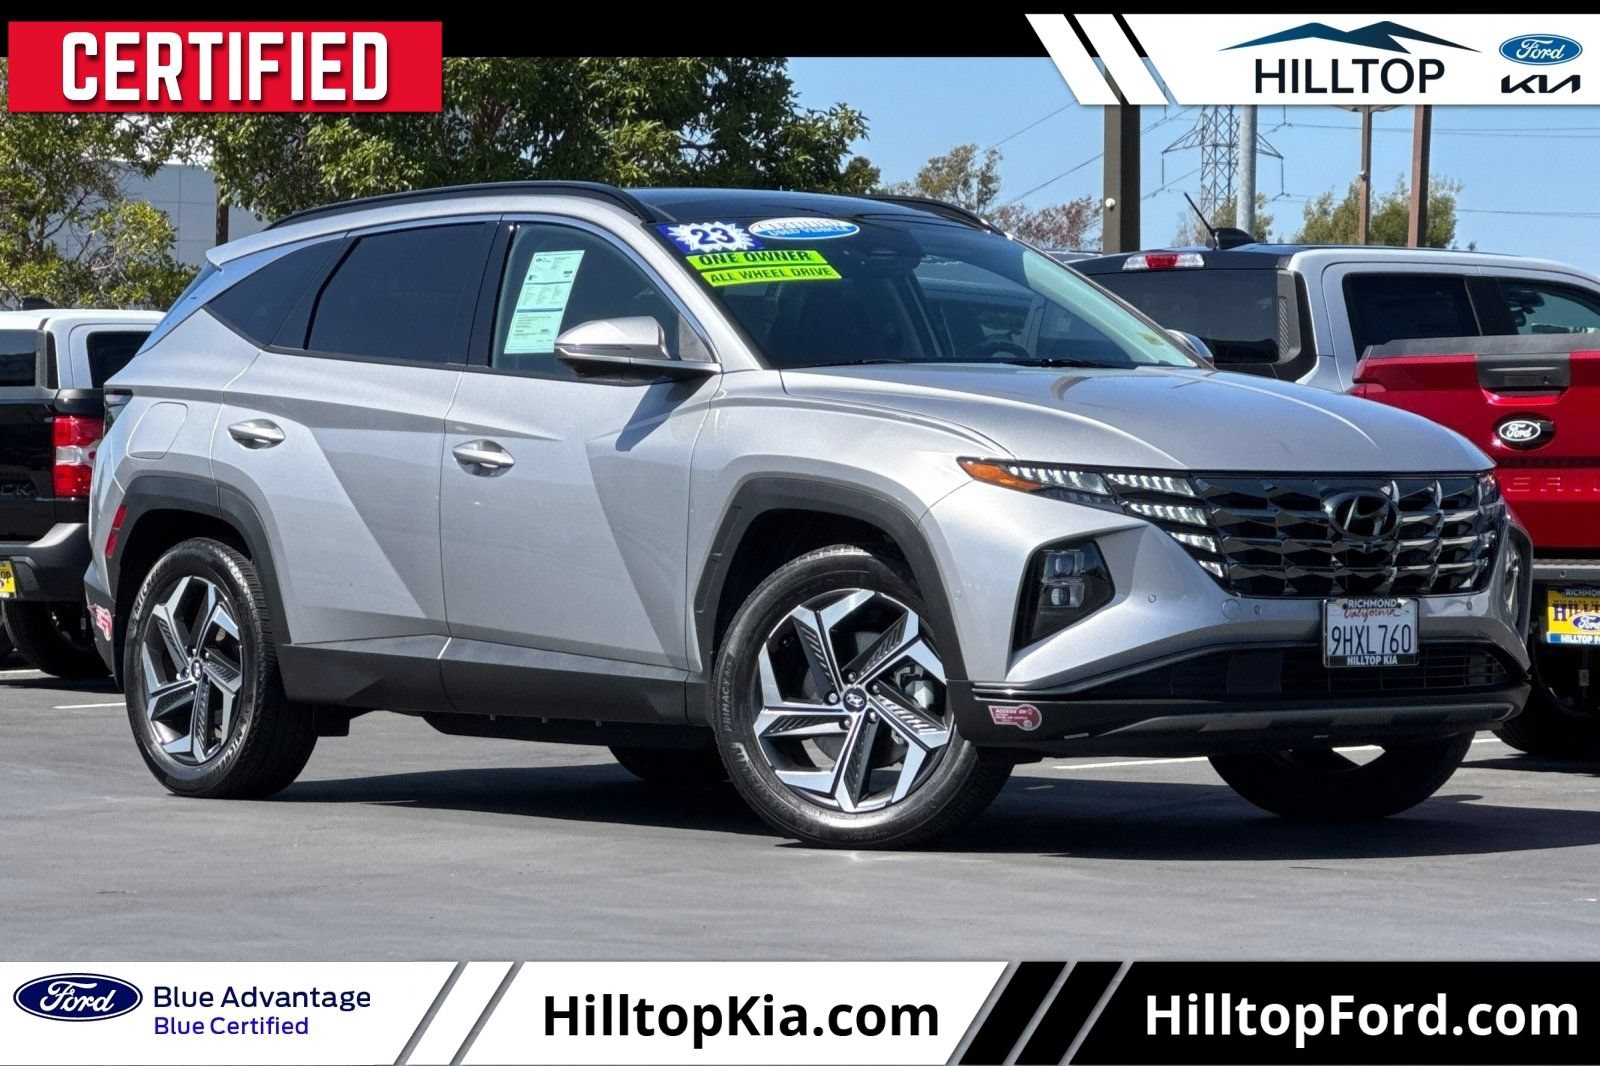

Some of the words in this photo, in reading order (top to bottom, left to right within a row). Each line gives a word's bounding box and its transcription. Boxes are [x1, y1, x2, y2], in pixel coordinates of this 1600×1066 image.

[690, 226, 737, 246] 23
[700, 251, 740, 266] ONE
[743, 250, 812, 263] OWNER
[710, 272, 737, 284] ALL
[740, 268, 788, 280] WHEEL
[794, 266, 833, 277] DRIVE
[1505, 422, 1533, 438] Ford
[1348, 599, 1397, 608] RICHMOND
[1343, 608, 1400, 623] California
[1331, 624, 1412, 656] 9HXL760
[1561, 634, 1593, 645] HILLTOP
[1346, 654, 1381, 666] HILLTOP
[1383, 654, 1398, 665] KIA
[721, 678, 733, 732] PRIMACY
